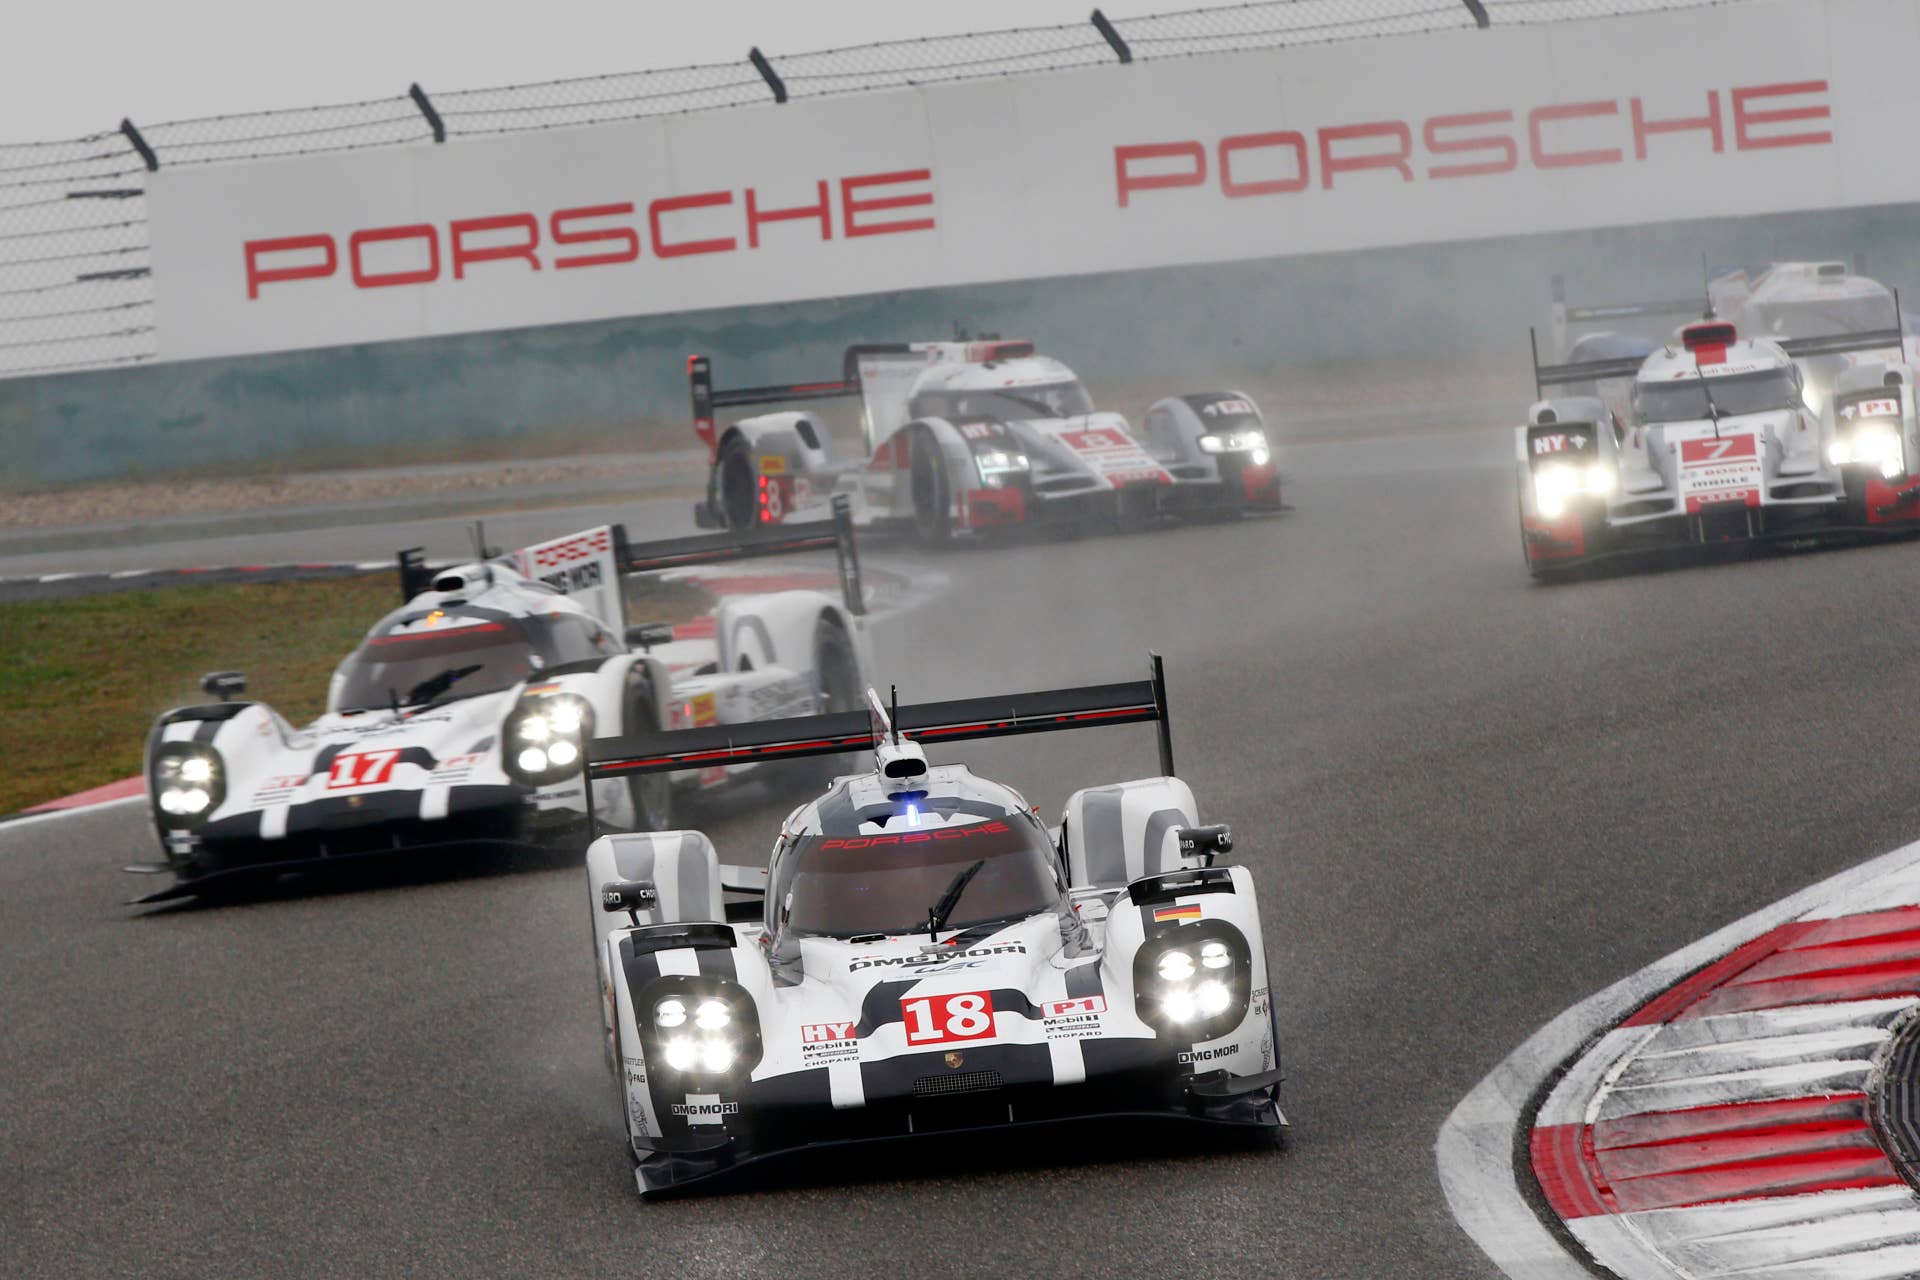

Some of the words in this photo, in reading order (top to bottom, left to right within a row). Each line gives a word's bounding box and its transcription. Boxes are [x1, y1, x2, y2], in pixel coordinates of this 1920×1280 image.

[1114, 80, 1832, 208] PORSCHE
[243, 168, 936, 300] PORSCHE
[1865, 402, 1892, 413] P1
[1080, 432, 1115, 450] 8
[1534, 434, 1566, 454] HY
[1702, 440, 1734, 460] 7
[768, 479, 782, 518] 8
[534, 531, 609, 567] PORSCHE
[330, 750, 400, 787] 17
[819, 821, 1010, 851] PORSCHE
[849, 955, 929, 973] DMG
[937, 946, 1027, 960] MORI
[1053, 999, 1095, 1014] P1
[905, 994, 991, 1042] 18
[1043, 1015, 1083, 1025] Mobil
[803, 1023, 852, 1042] HY
[1047, 1030, 1102, 1039] CHOPARD
[802, 1042, 842, 1051] Mobil
[1178, 1050, 1212, 1063] DMG
[1213, 1044, 1239, 1059] MORI
[804, 1056, 860, 1067] CHOPARD
[672, 1104, 698, 1115] DMG
[699, 1103, 738, 1114] MORI
